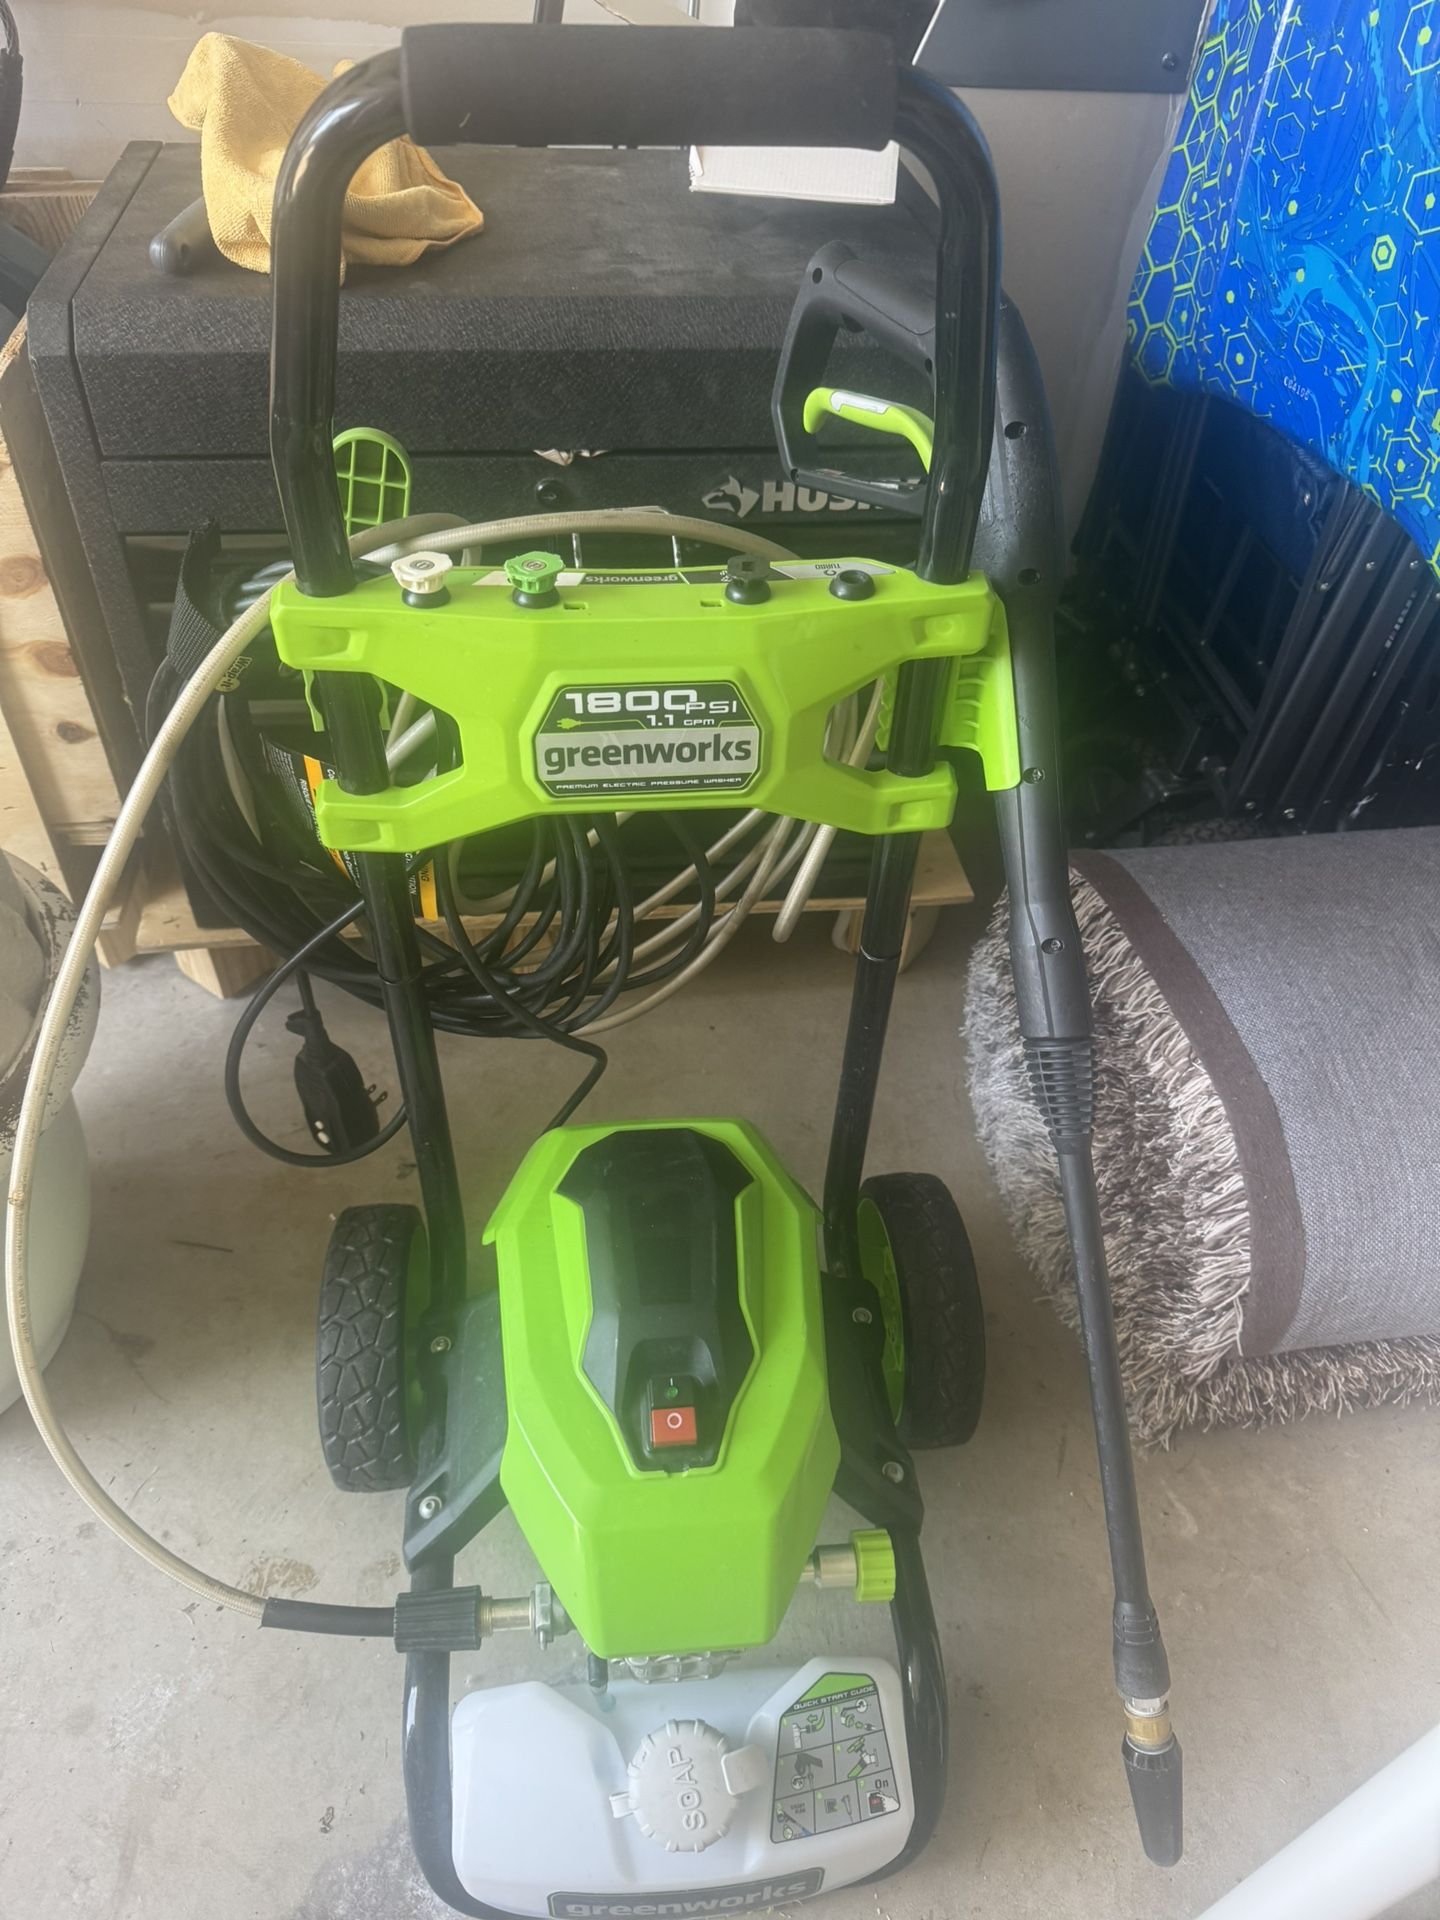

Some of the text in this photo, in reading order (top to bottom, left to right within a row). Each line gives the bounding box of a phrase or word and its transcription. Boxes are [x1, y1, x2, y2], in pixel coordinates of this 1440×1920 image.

[585, 574, 679, 584] greenworks
[565, 689, 737, 715] 1800 PSI
[646, 714, 715, 726] 1.1 GPM
[544, 733, 752, 775] greenworks
[793, 1685, 875, 1711] QUICK START GUIDE
[667, 1745, 707, 1831] SOAP
[875, 1779, 889, 1789] On
[565, 1880, 807, 1917] greenworks
